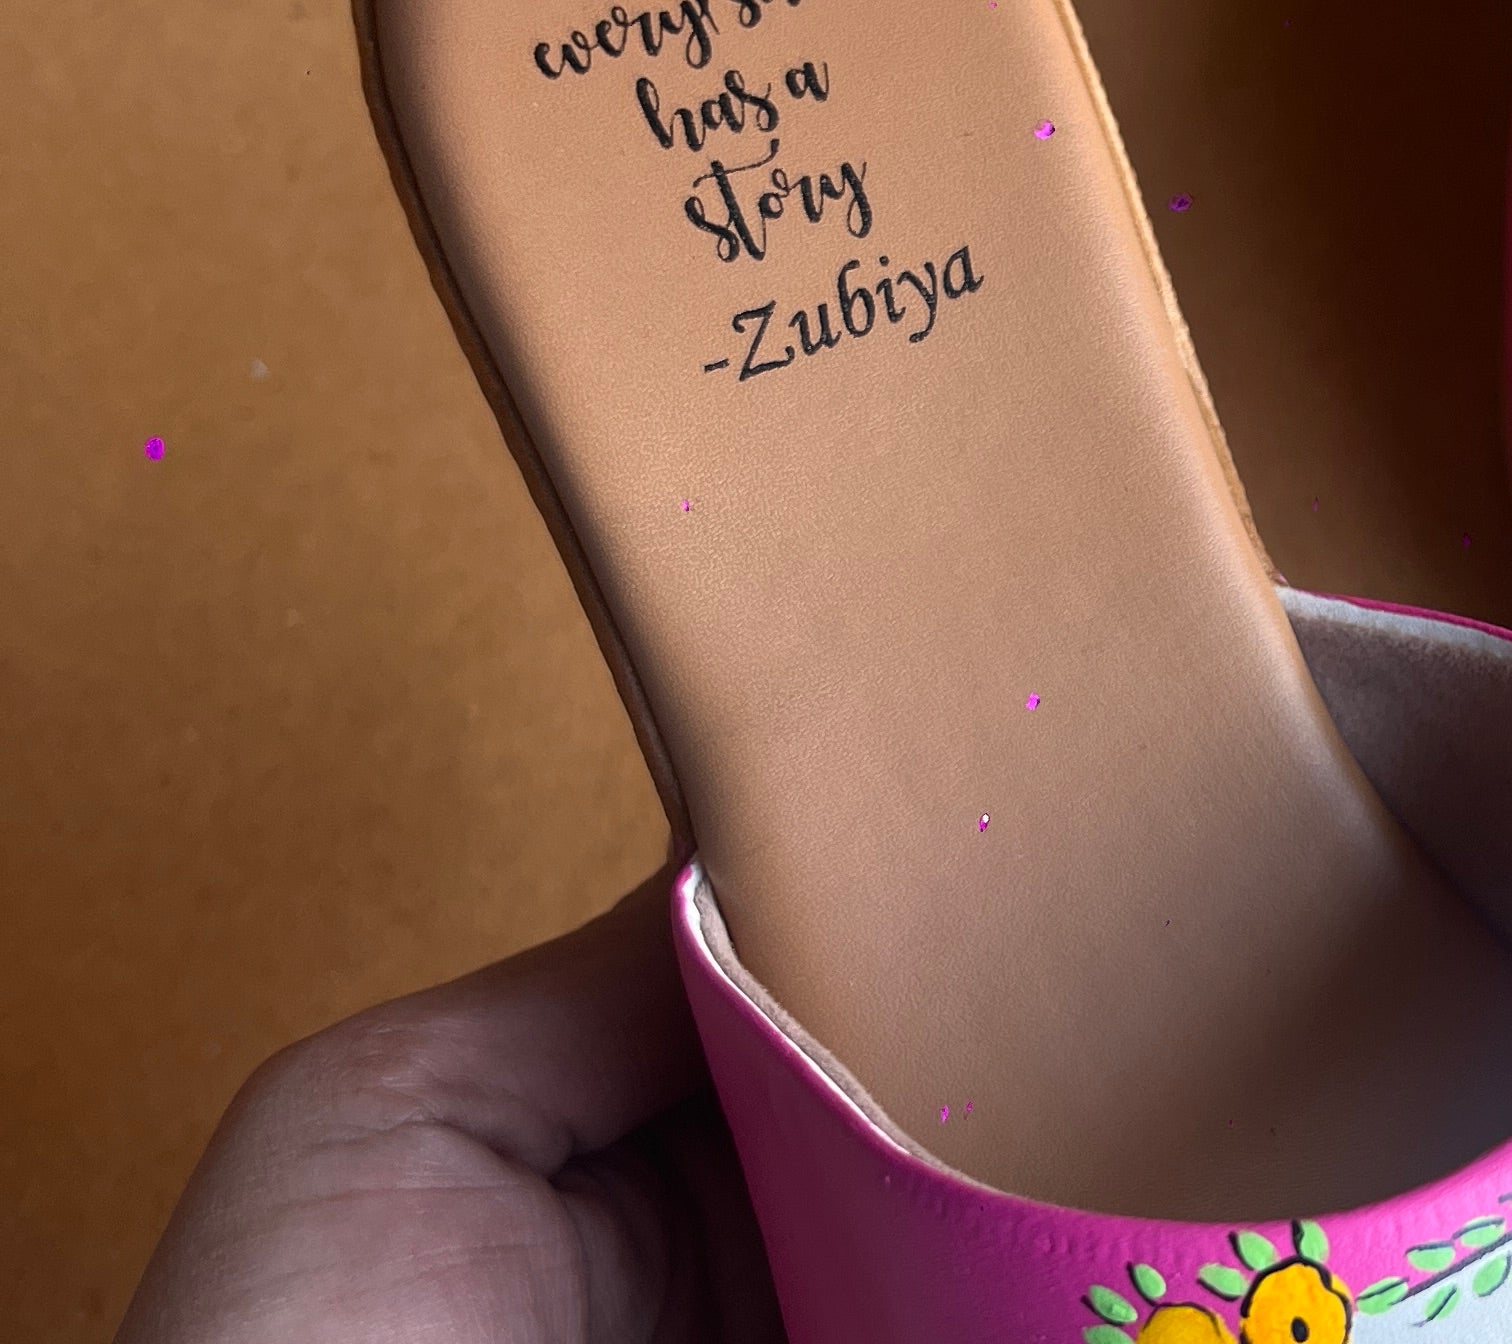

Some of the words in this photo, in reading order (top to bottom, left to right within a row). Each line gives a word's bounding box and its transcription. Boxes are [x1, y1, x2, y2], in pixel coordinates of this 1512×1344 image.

[635, 69, 781, 151] has
[784, 61, 829, 102] a
[684, 138, 872, 264] story
[703, 245, 986, 382] -Zubiya
